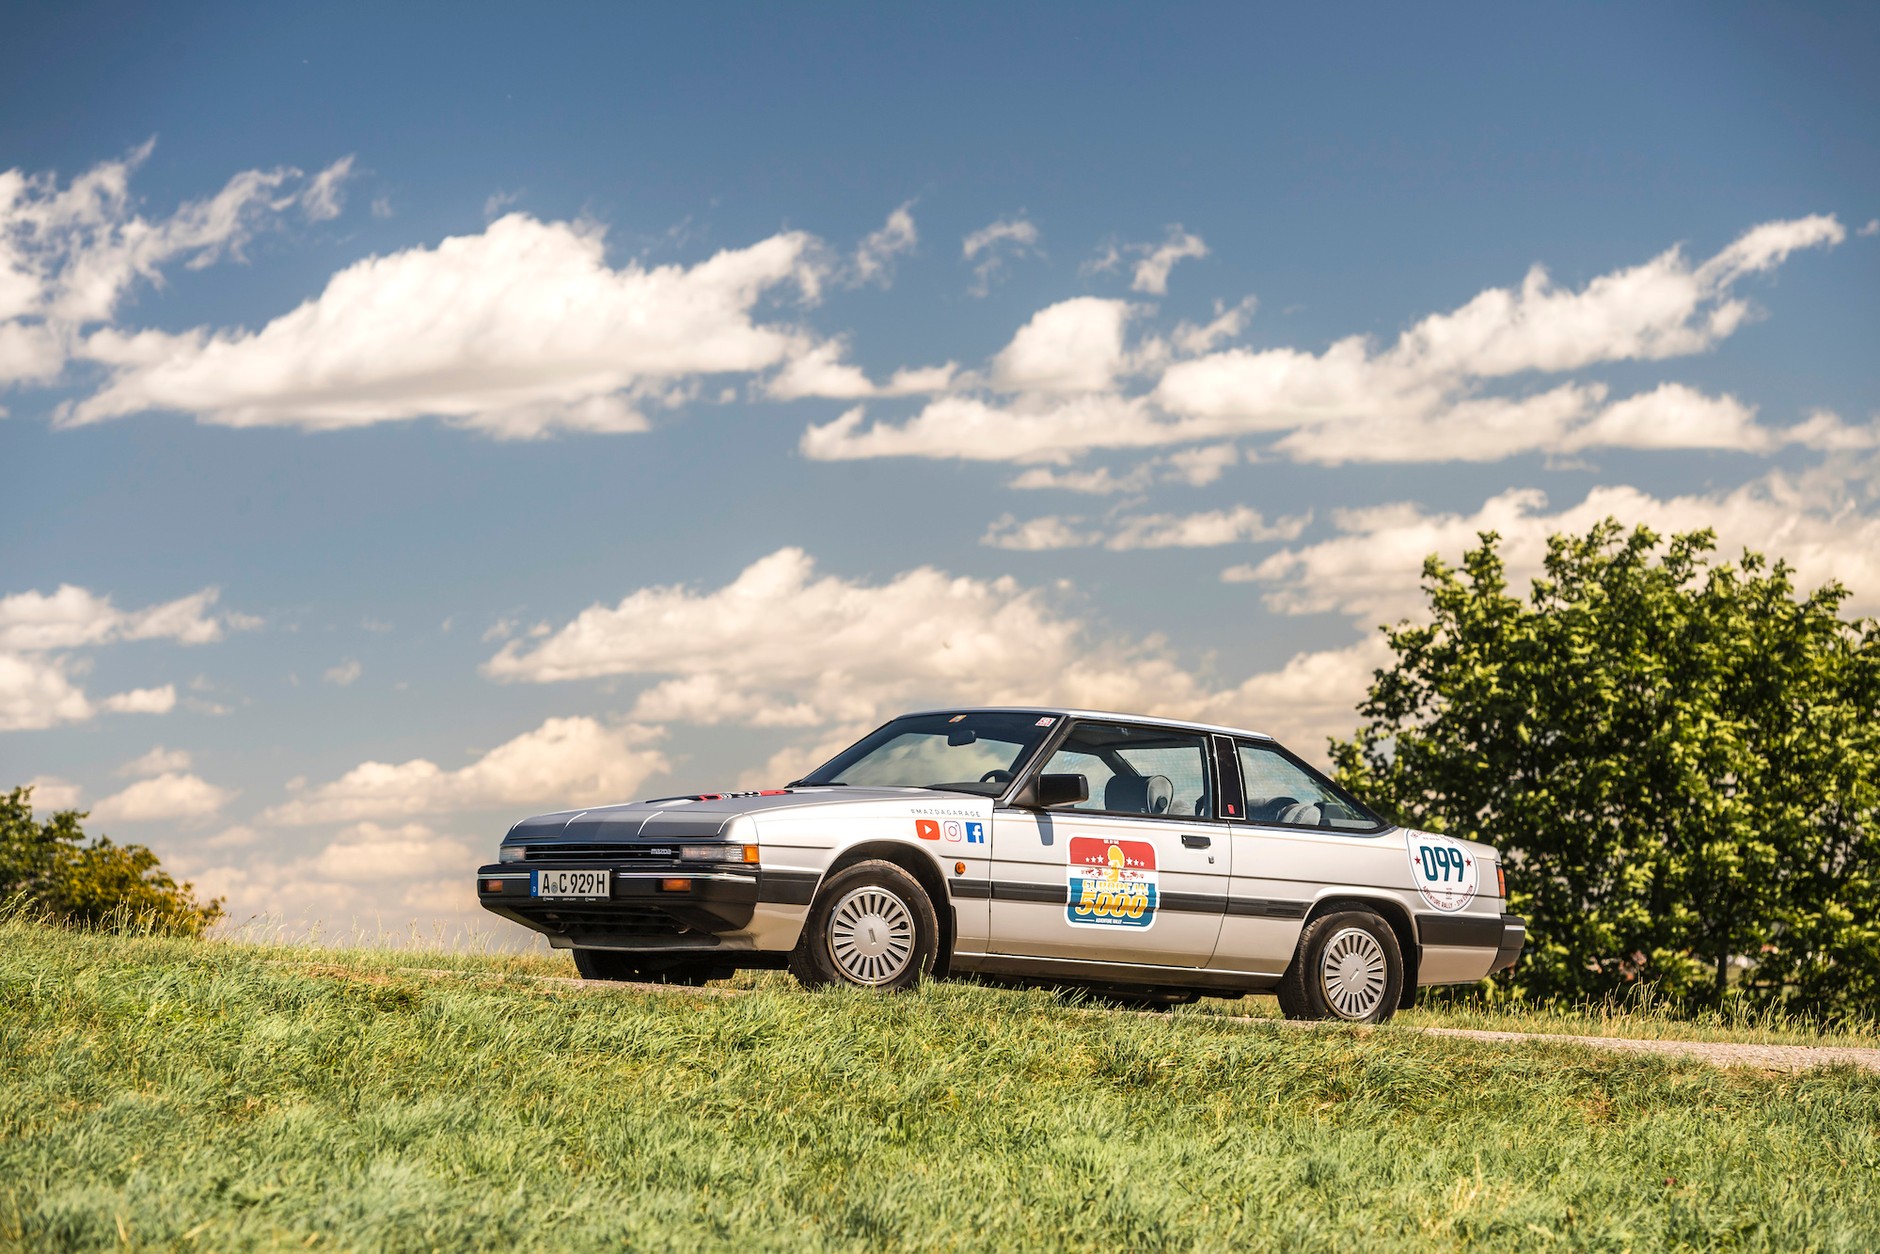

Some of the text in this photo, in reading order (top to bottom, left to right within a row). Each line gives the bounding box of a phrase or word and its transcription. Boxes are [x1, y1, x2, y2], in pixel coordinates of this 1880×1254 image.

[1420, 845, 1464, 882] 099
[542, 873, 550, 894] A
[1082, 879, 1149, 896] EUROPEAN
[1075, 891, 1148, 919] 5000
